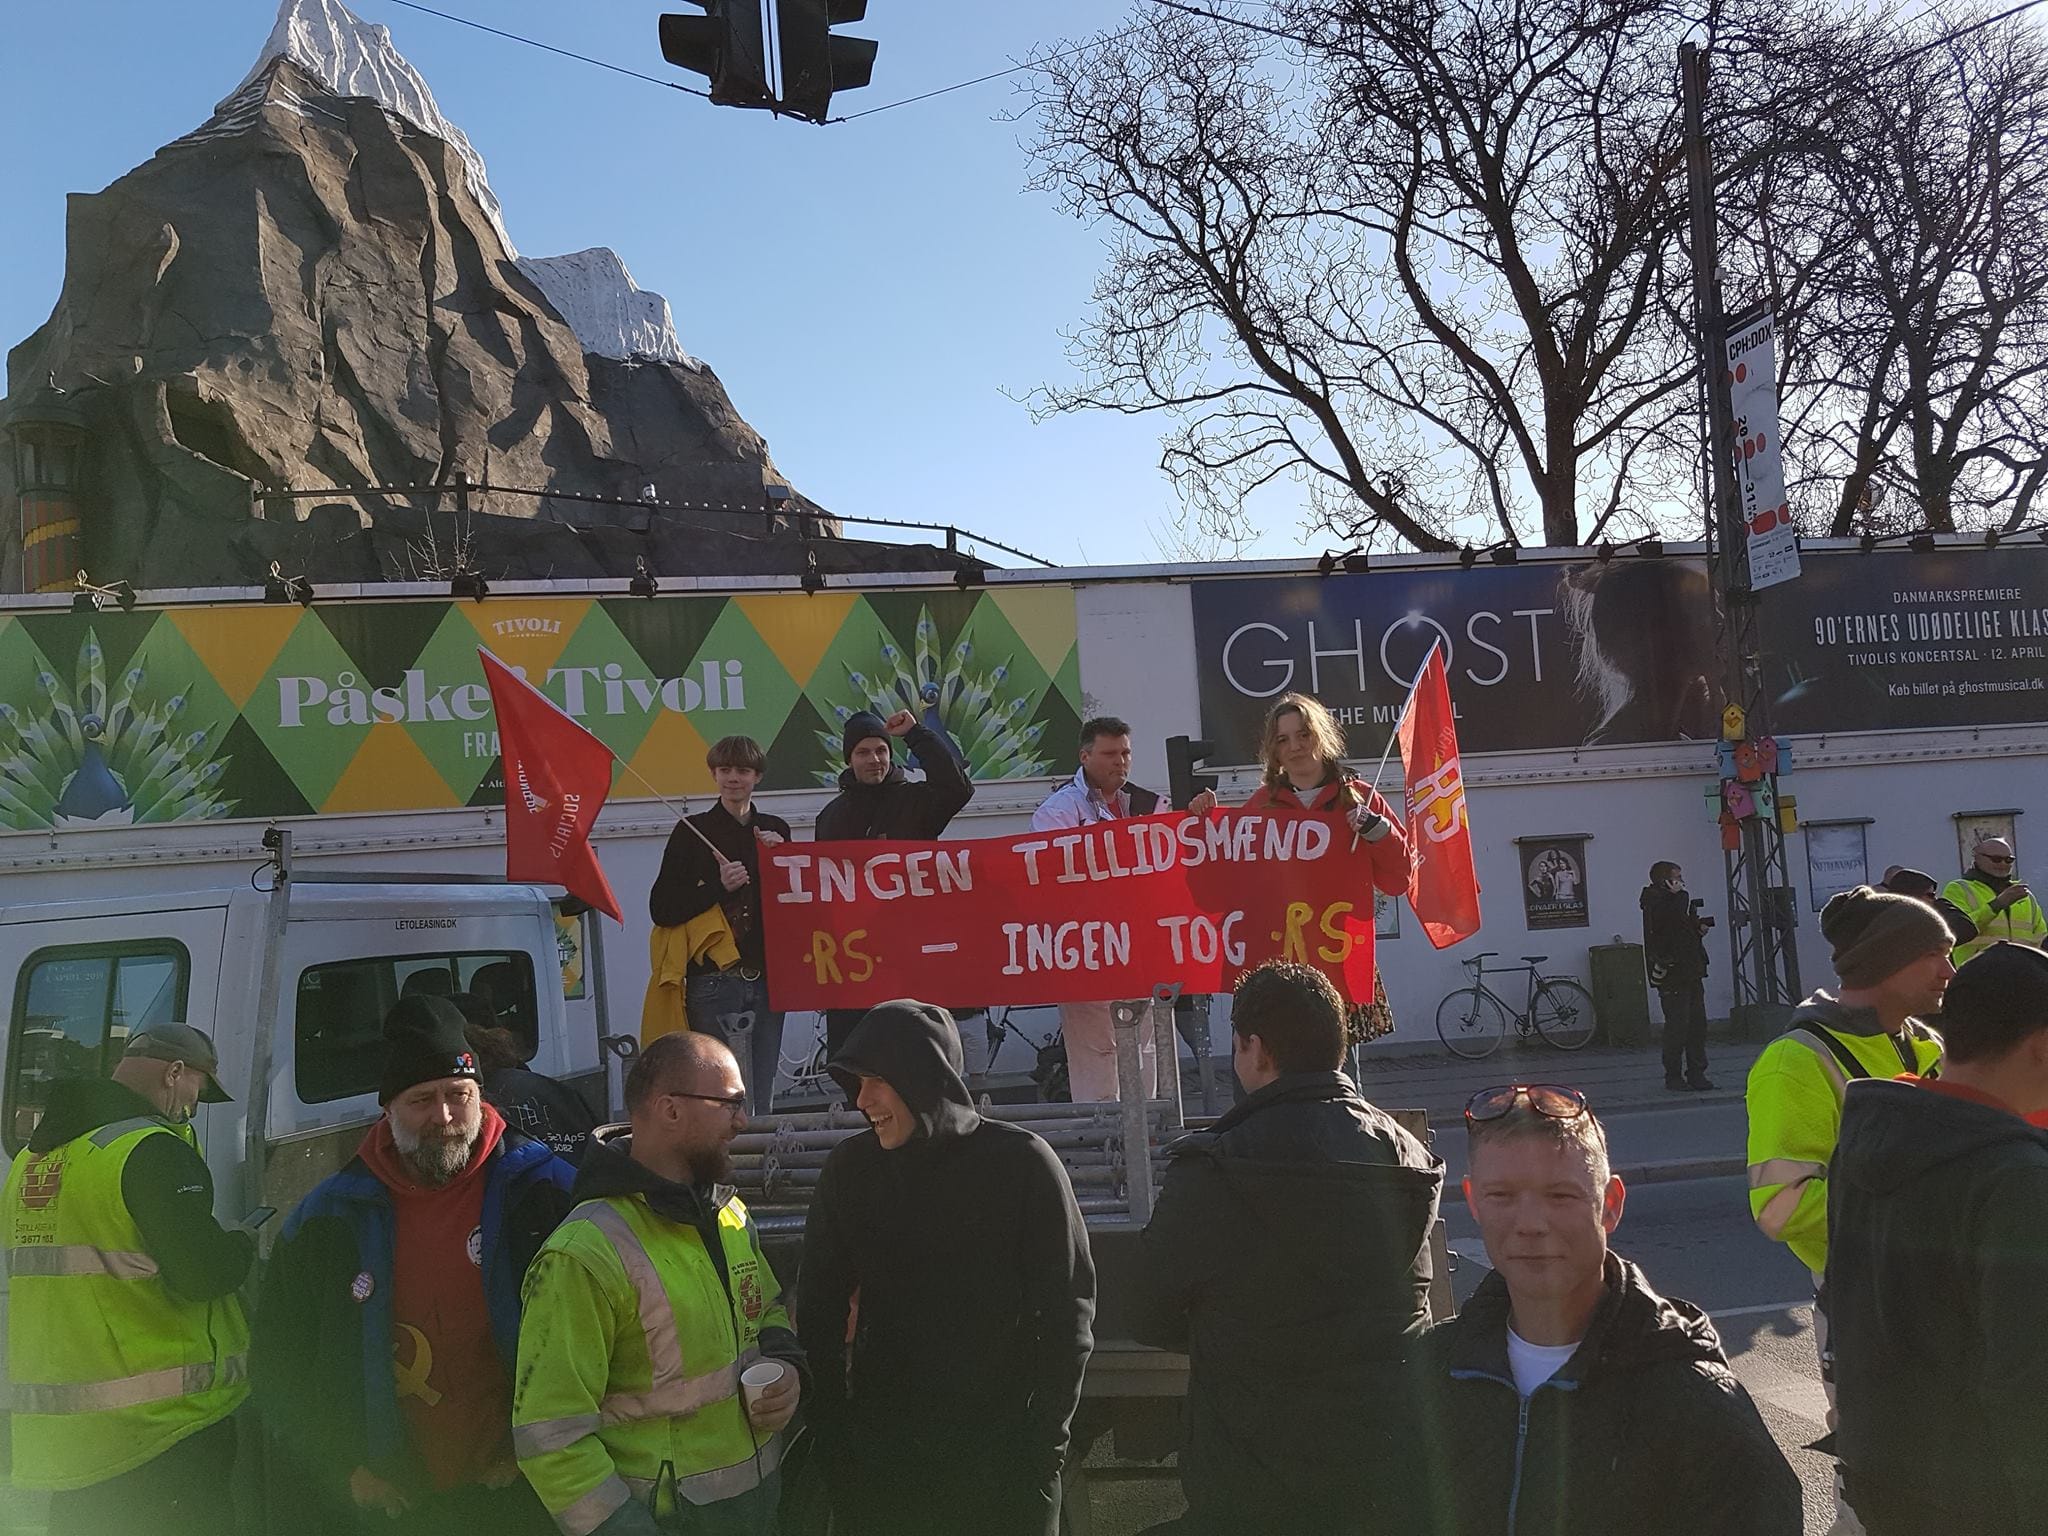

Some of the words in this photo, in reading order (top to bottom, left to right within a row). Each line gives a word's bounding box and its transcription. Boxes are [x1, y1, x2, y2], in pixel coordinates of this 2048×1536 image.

[1729, 322, 1772, 360] CPH:DOX
[1894, 588, 2021, 603] DANMARKSPREMIERE
[493, 617, 562, 635] TIVOLI
[1815, 613, 1900, 645] 90'ERNES
[1907, 610, 2003, 641] UDØDELIGE
[1222, 608, 1554, 698] GHOST
[1848, 652, 1897, 666] TIVOLIS
[1901, 649, 1980, 664] KONCERTSAL
[2011, 647, 2046, 659] APRIL
[276, 669, 491, 728] Påske
[546, 659, 746, 716] Tivoli
[1889, 683, 1910, 697] Køb
[1913, 681, 1939, 695] billet
[1942, 680, 1956, 697] på
[1959, 678, 2045, 697] ghostmusical.dk
[773, 849, 973, 904] INGEN
[1012, 814, 1331, 886] TILLIDSMÆND
[1002, 920, 1130, 976] INGEN
[1157, 910, 1246, 967] TOG
